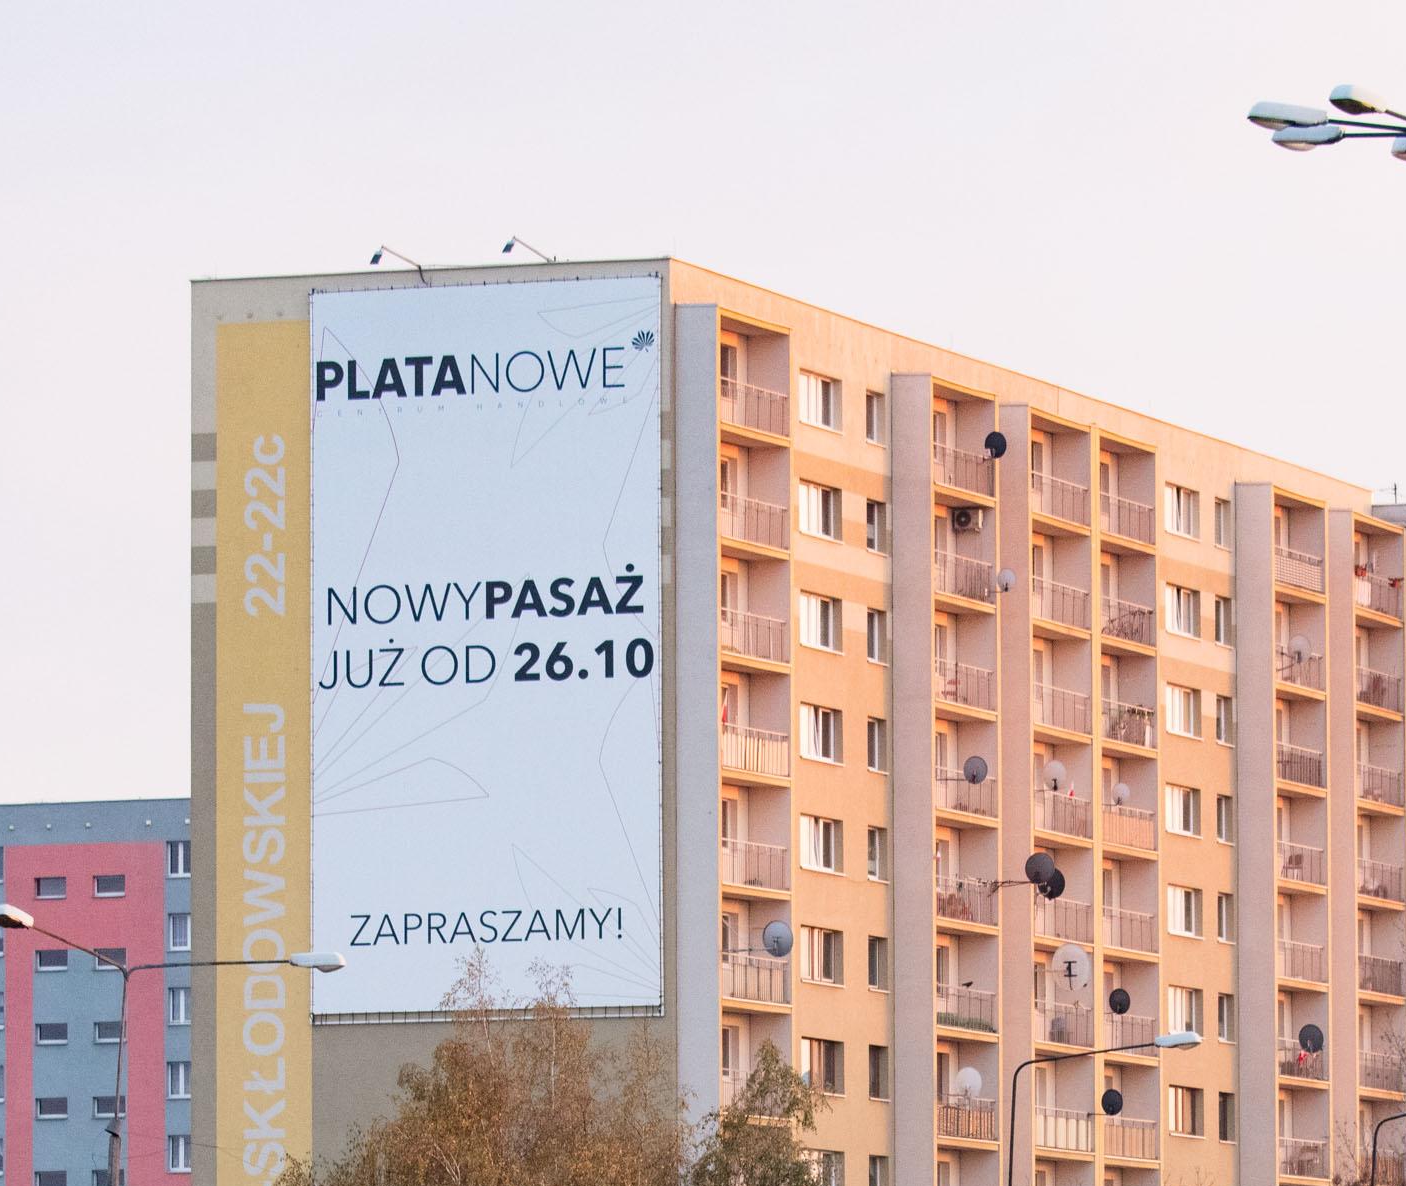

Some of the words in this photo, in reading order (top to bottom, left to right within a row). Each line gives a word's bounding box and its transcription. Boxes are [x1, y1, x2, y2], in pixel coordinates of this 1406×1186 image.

[316, 347, 625, 402] PLATANOWE
[317, 405, 445, 418] CENTRUM
[476, 397, 629, 412] HANDLOWE
[243, 433, 286, 617] 22-22c
[318, 638, 405, 690] JUŻ
[421, 644, 496, 686] OD
[514, 637, 655, 682] 26.10
[349, 907, 623, 946] ZAPRASZAMY!
